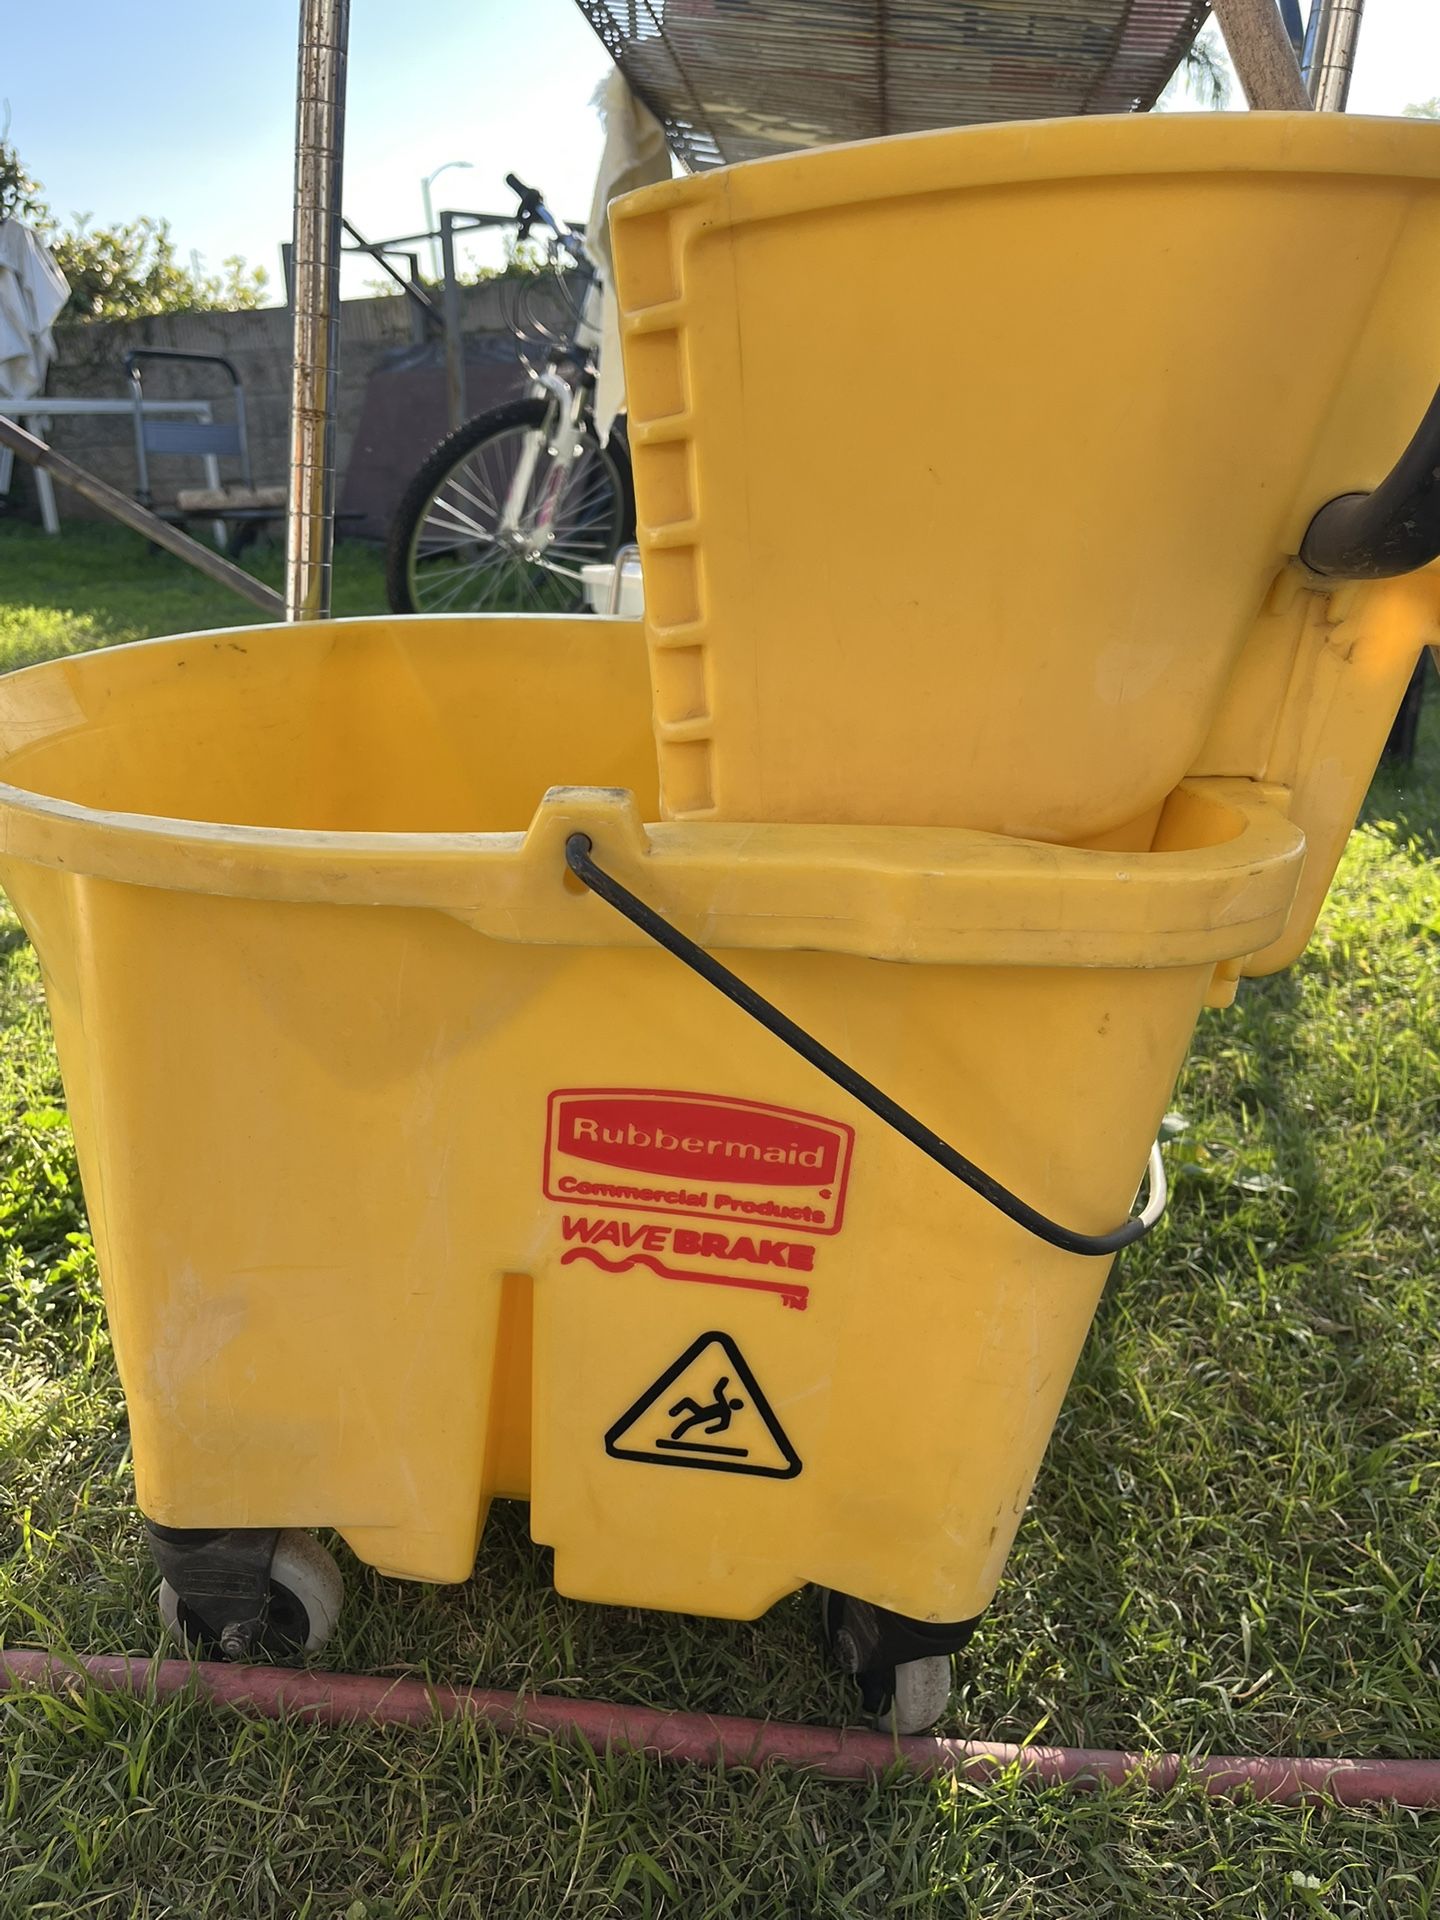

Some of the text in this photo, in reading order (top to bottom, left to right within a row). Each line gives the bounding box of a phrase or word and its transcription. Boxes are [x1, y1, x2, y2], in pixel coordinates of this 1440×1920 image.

[573, 1117, 825, 1168] Rubbermaid
[558, 1176, 826, 1224] Commercial Products
